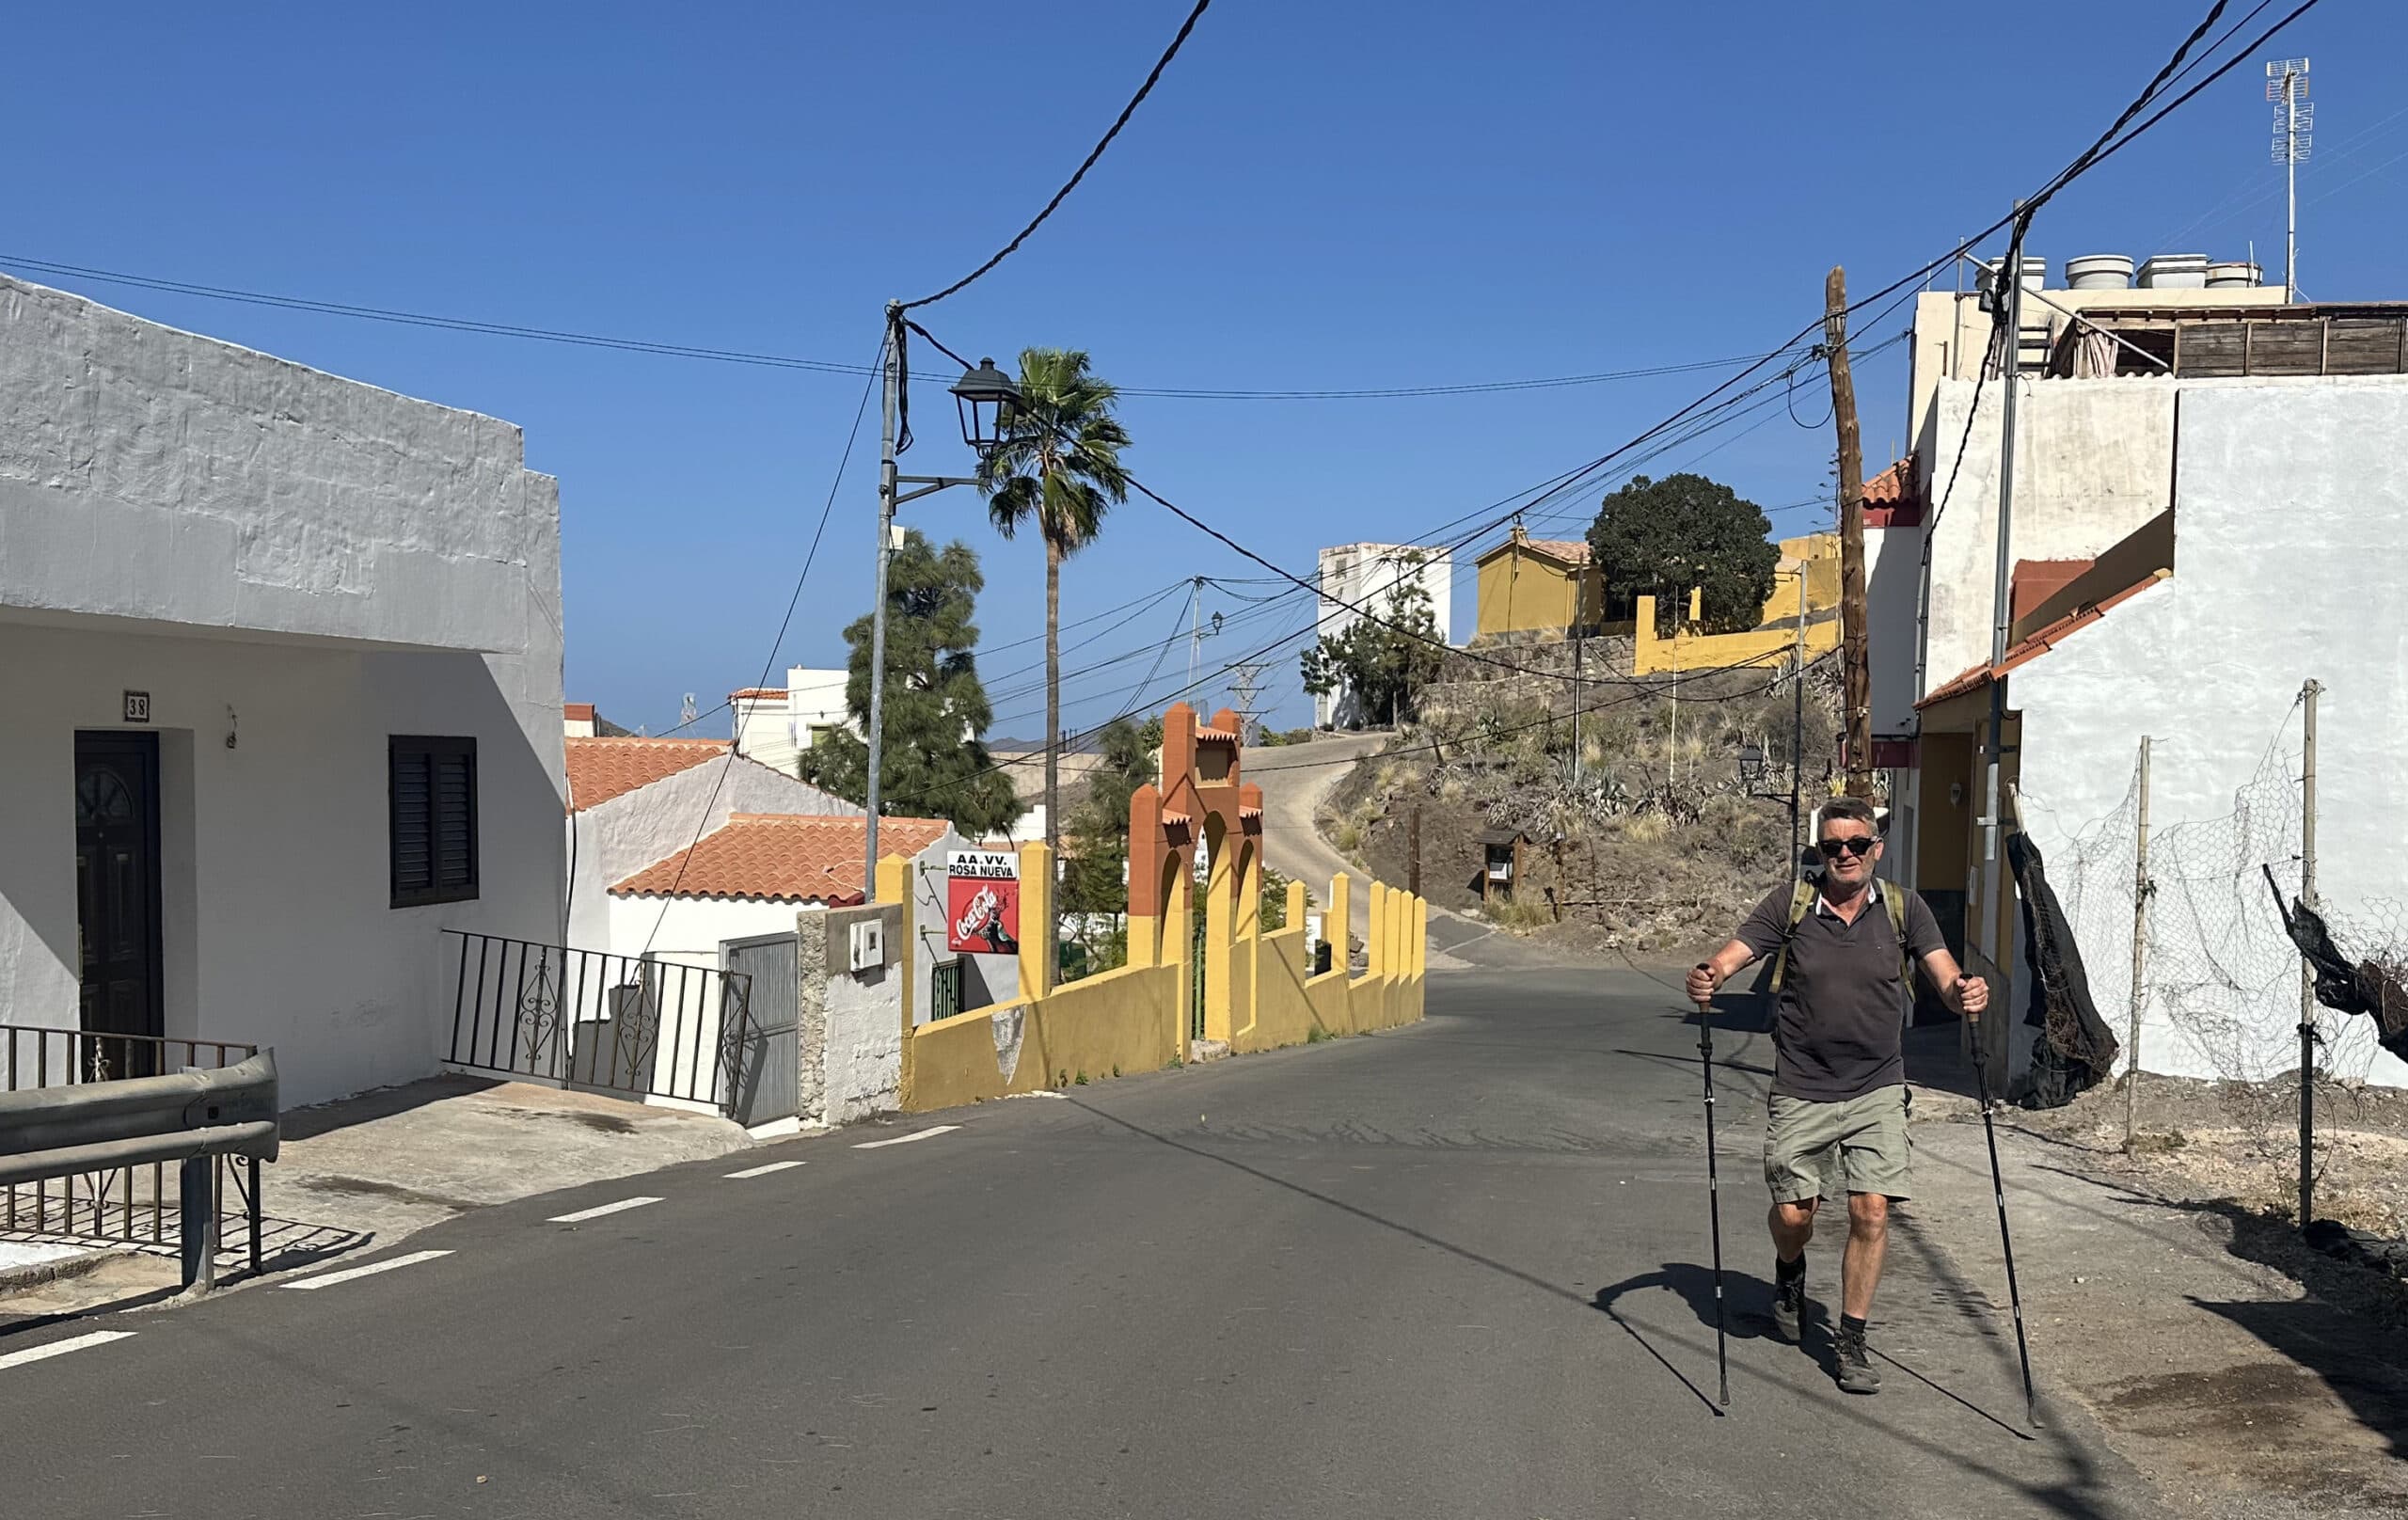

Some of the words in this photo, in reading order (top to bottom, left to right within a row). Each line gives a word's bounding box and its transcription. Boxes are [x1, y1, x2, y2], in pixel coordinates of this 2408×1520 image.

[129, 698, 145, 716] 38
[957, 854, 1007, 865] AA.VV.
[949, 864, 977, 876] ROSA
[980, 865, 1013, 877] NUEVA
